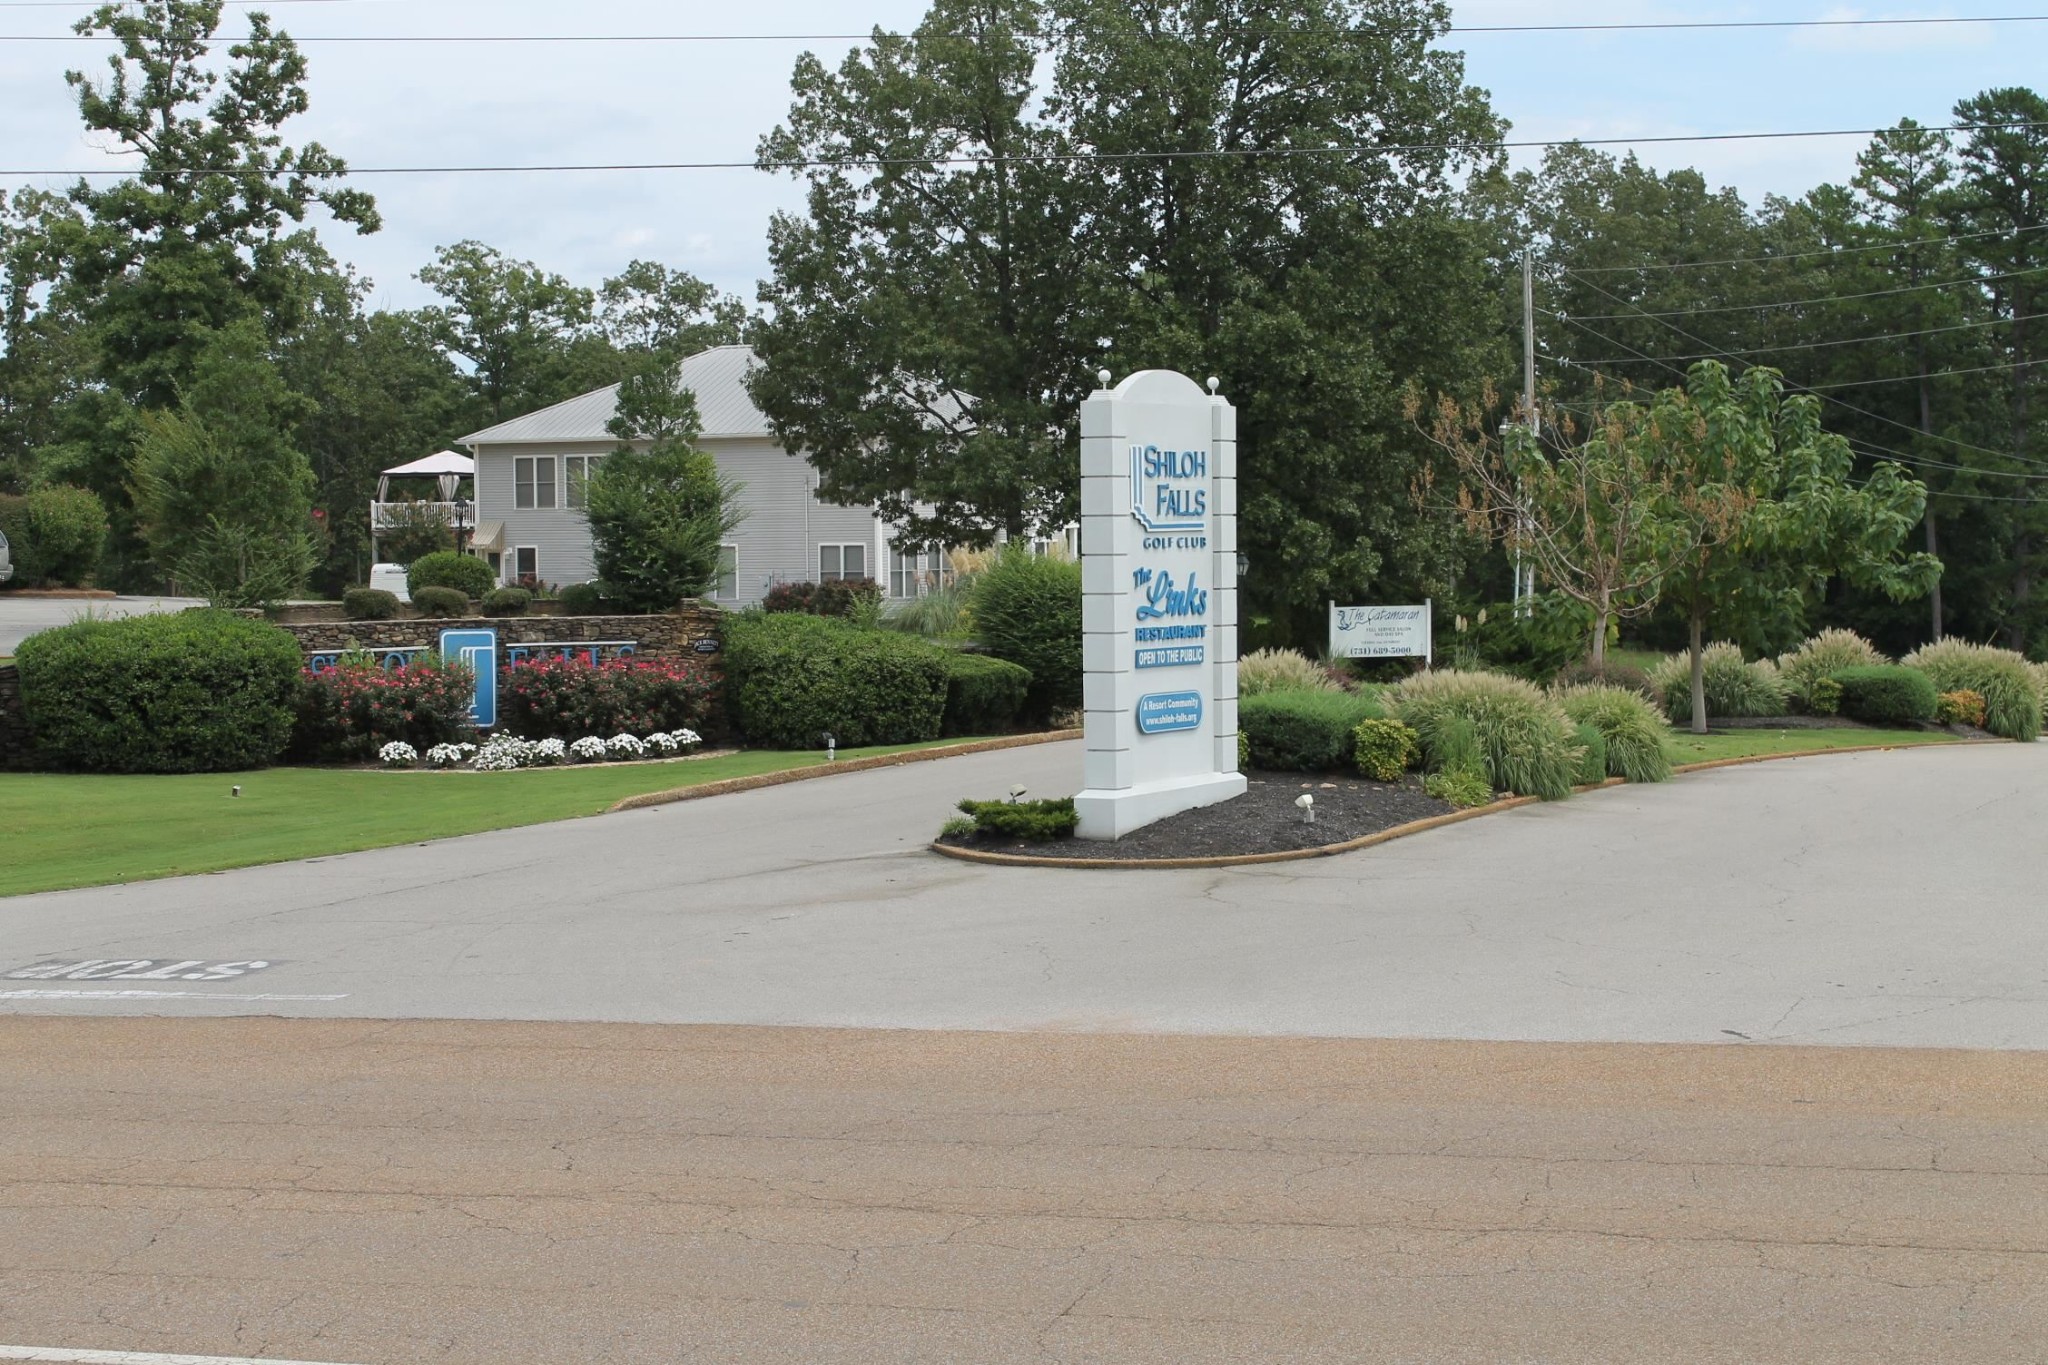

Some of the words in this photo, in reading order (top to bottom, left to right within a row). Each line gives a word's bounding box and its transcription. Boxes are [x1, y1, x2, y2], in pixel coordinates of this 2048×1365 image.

[1144, 445, 1206, 479] SHILOH
[1156, 483, 1206, 517] FALLS
[1142, 537, 1174, 550] GOLF
[1176, 536, 1207, 549] CLUB
[1136, 569, 1207, 621] Links
[1348, 608, 1365, 621] The
[1367, 607, 1420, 621] Catamaran
[1134, 624, 1207, 642] RESTAURANT
[1138, 652, 1156, 665] OPEN
[1157, 650, 1166, 664] TO
[1167, 649, 1179, 663] THE
[1180, 648, 1203, 663] PUBLIC
[1350, 647, 1371, 655] (731)
[1143, 701, 1148, 711] A
[1149, 700, 1167, 711] Resort
[1168, 697, 1199, 709] Community
